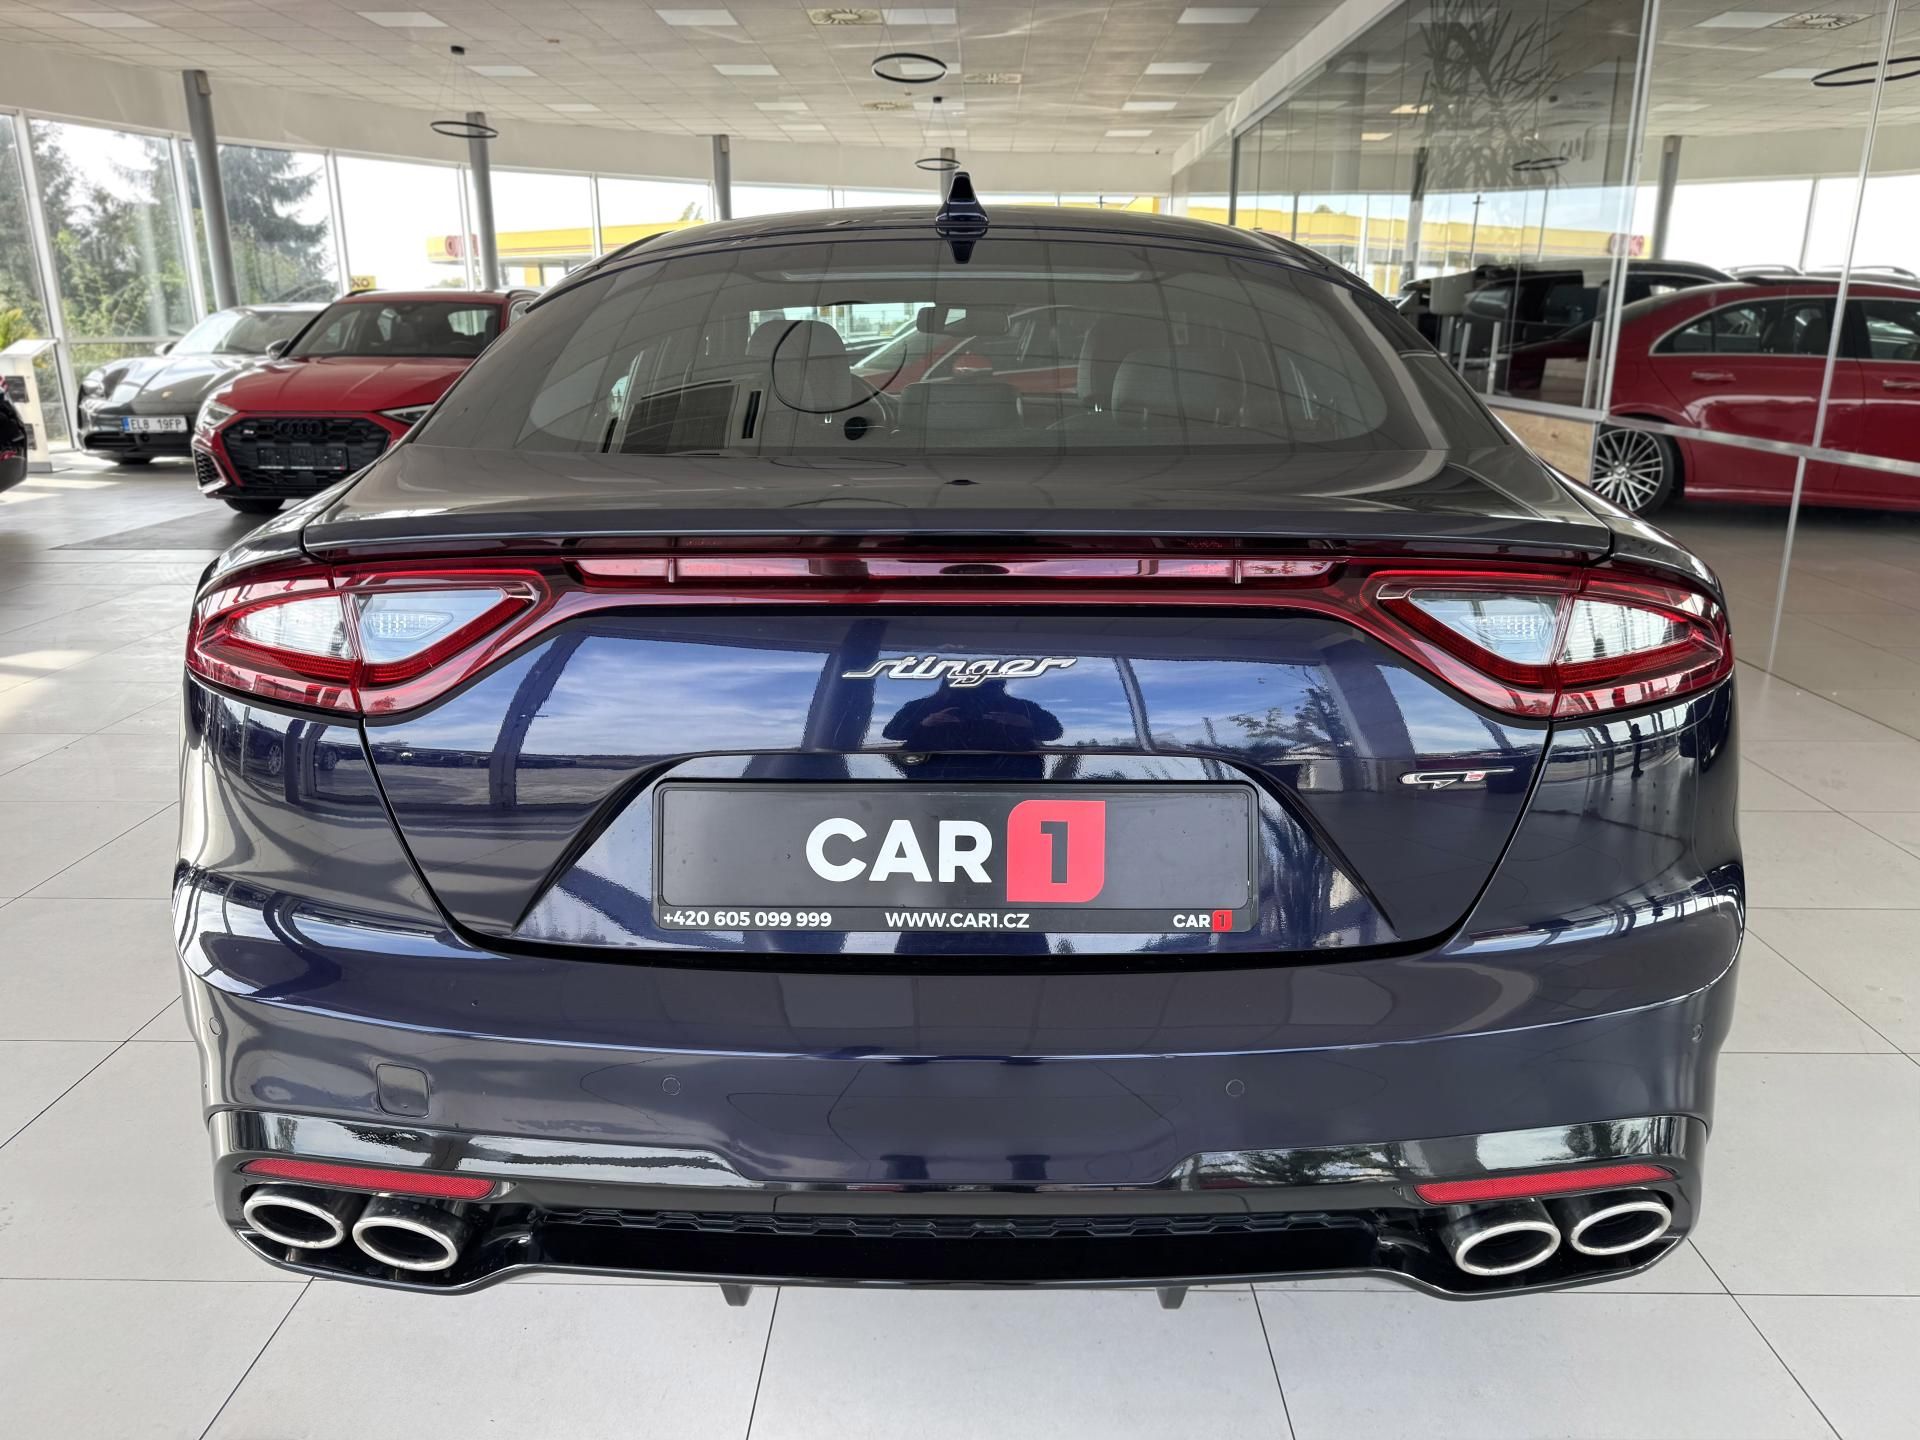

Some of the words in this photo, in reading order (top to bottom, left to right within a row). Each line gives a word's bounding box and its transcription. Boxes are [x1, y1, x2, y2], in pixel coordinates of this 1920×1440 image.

[806, 817, 993, 883] CAR
[663, 911, 710, 926] +420
[714, 911, 751, 926] 605
[755, 912, 792, 927] 099
[796, 912, 832, 927] 999
[885, 912, 1030, 928] WWW.CAR1.CZ
